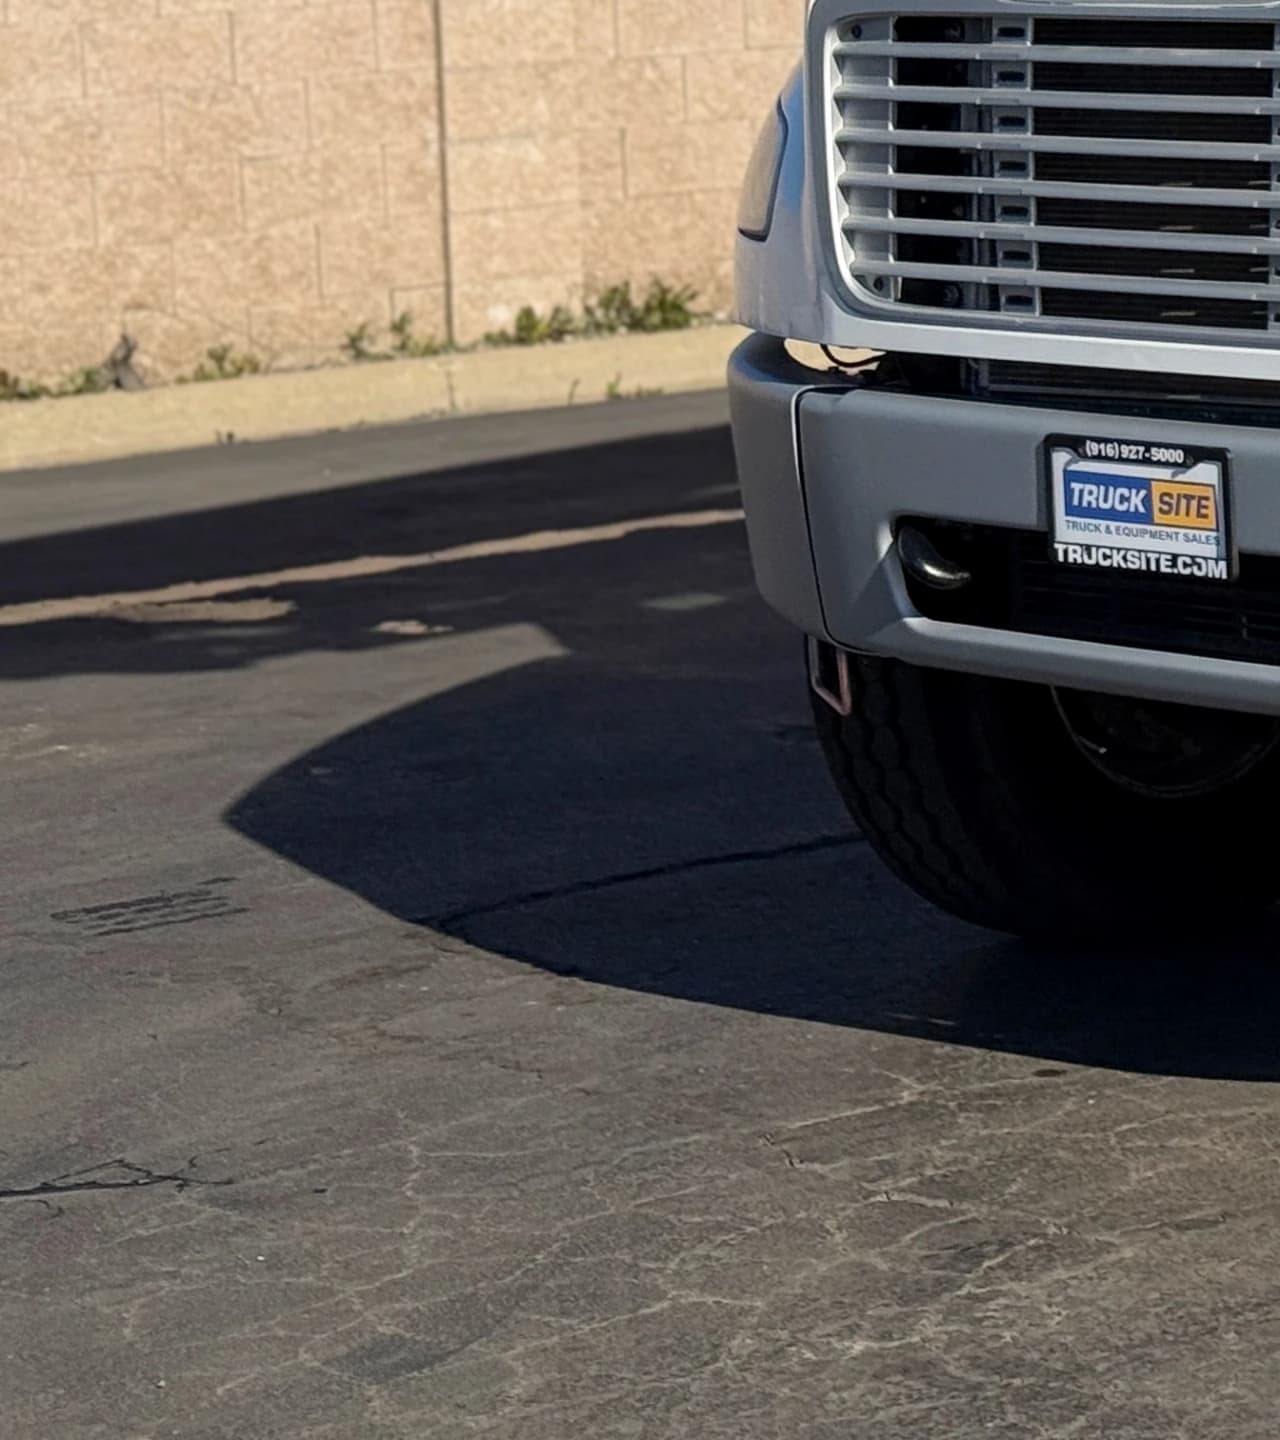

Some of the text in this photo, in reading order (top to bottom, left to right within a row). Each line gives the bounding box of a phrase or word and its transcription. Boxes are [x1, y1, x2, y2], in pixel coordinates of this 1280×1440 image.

[1070, 482, 1210, 519] TRUCK SITE
[1065, 520, 1220, 546] TRUCK & EQUIPMENT SALES
[1055, 544, 1227, 579] TRUCKSITE.COM
